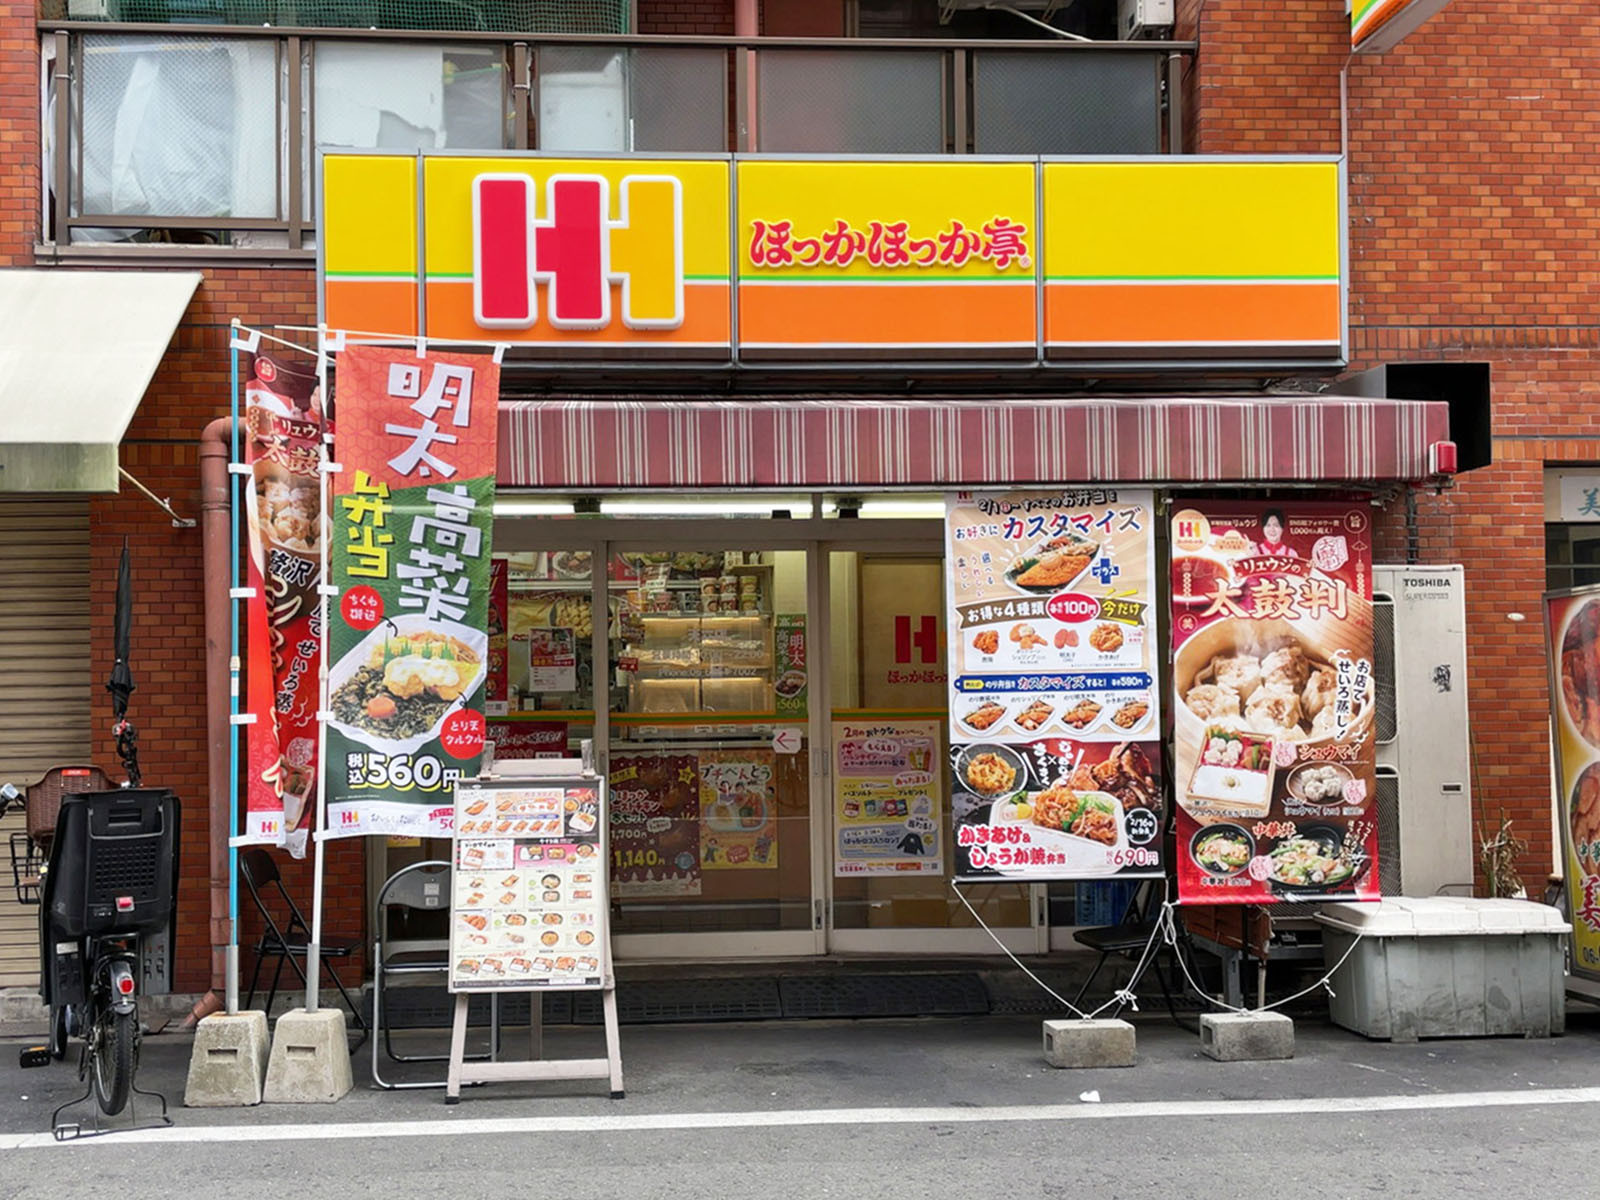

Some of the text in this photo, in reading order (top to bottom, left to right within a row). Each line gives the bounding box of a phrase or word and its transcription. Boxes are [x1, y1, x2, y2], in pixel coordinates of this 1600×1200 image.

[749, 217, 1029, 271] ほっかほっか亭
[342, 469, 395, 578] 弁当
[956, 506, 1141, 540] お好きに カスタマイズ
[1243, 555, 1301, 573] リュウジの
[1403, 578, 1451, 587] TOSHIBA
[1201, 577, 1350, 620] 太鼓判
[968, 600, 1045, 622] お得な4種類
[1102, 601, 1140, 617] 今だけ
[1354, 660, 1369, 701] お店で
[450, 720, 479, 731] とり天
[1299, 744, 1361, 760] シュウマイ
[366, 752, 460, 790] 560円
[1114, 849, 1159, 866] 690円
[1582, 946, 1600, 964] 06-
